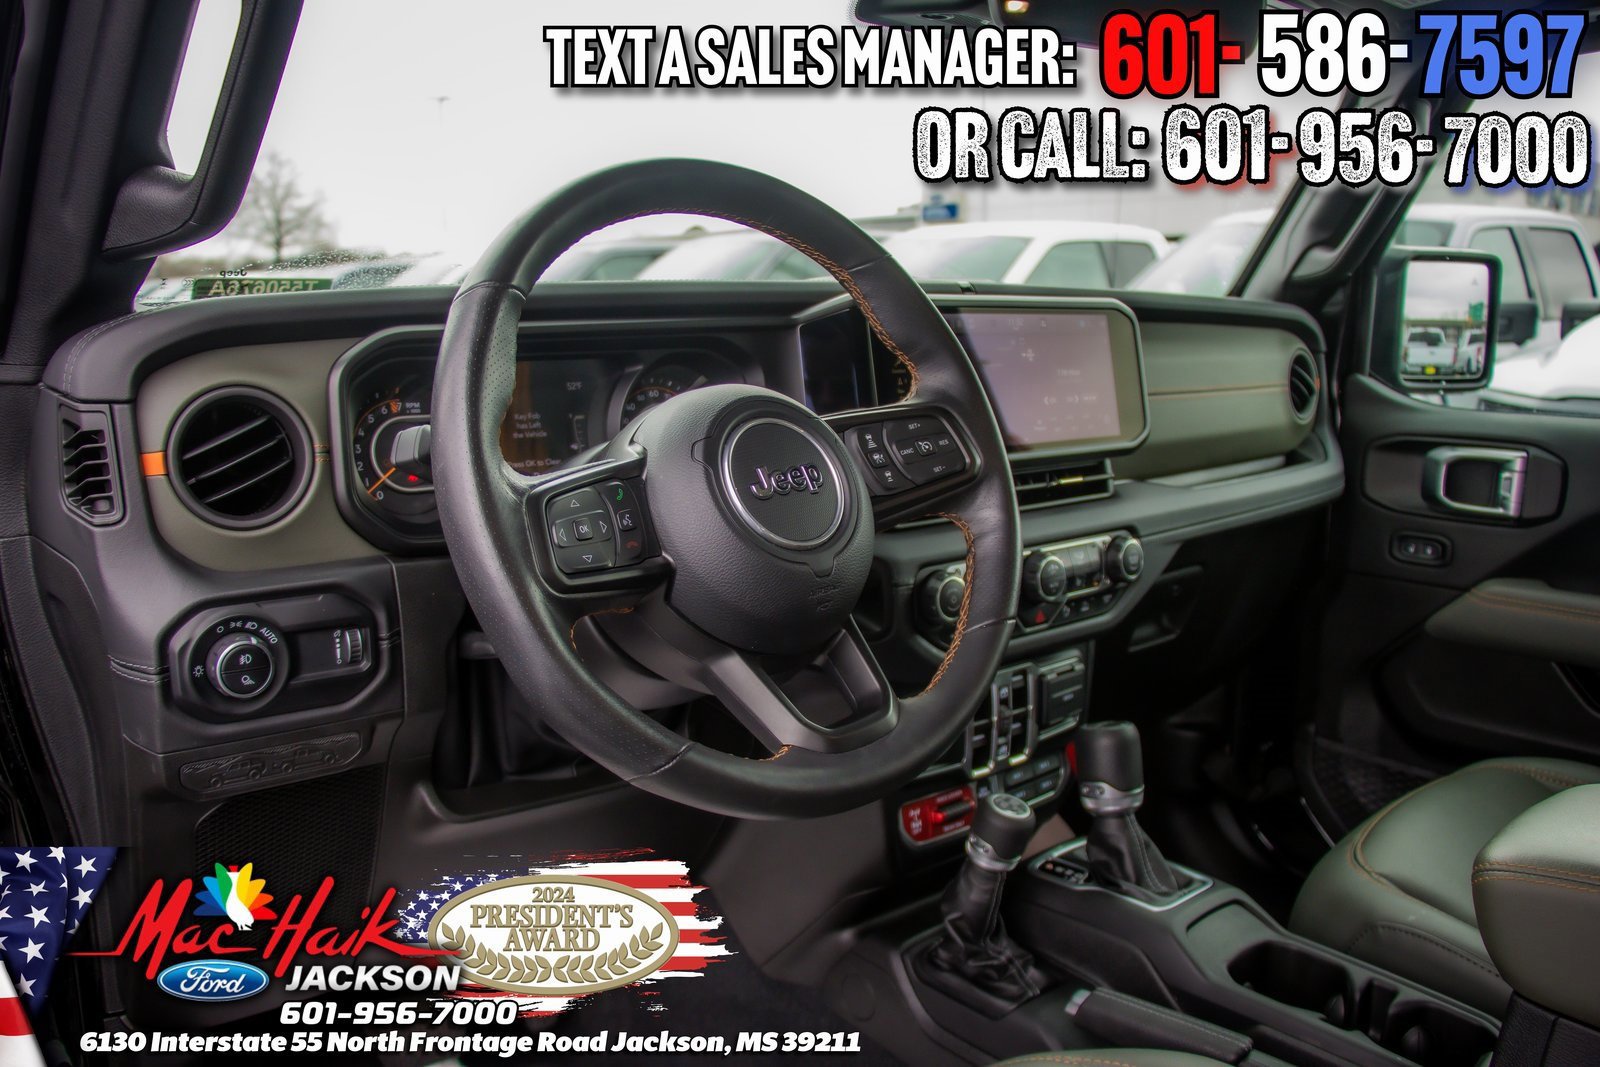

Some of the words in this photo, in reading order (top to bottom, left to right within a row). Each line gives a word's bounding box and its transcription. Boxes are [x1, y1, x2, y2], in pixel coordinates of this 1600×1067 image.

[381, 405, 389, 415] 6
[367, 414, 375, 424] 5
[358, 428, 365, 437] 4
[355, 444, 362, 454] 3
[357, 461, 364, 471] 2
[750, 463, 823, 500] Jeep
[376, 490, 385, 500] 0
[579, 524, 590, 534] OK
[260, 627, 279, 645] AUTO
